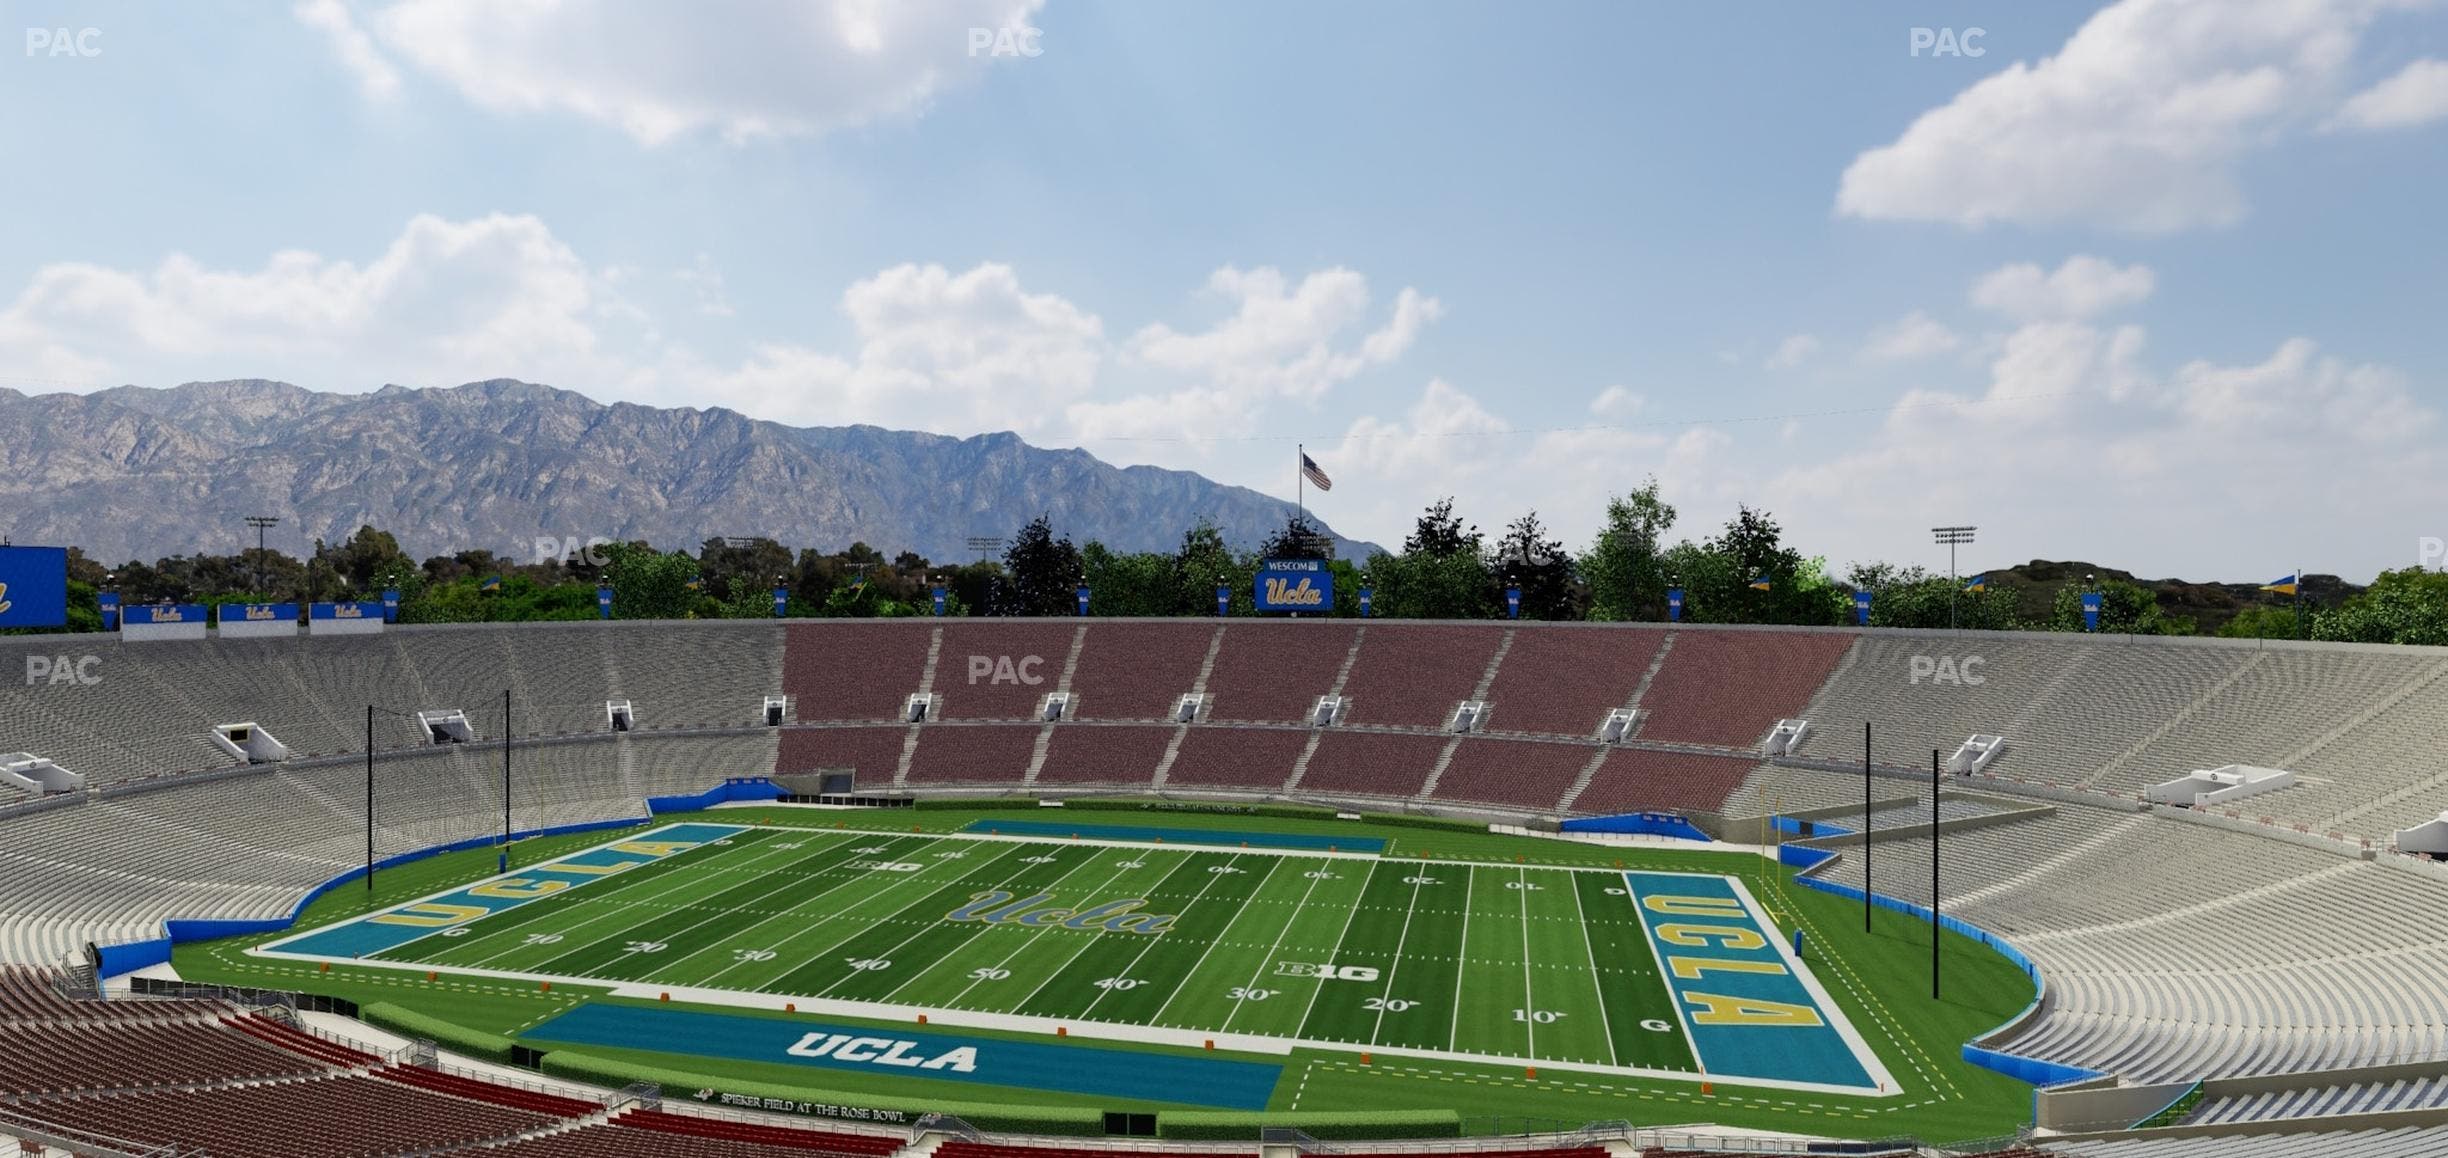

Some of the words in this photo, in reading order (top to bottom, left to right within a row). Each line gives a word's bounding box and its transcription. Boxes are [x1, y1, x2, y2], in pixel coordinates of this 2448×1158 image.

[1268, 561, 1307, 571] WESCOM
[1265, 577, 1322, 605] Ucla
[365, 841, 701, 928] UCLA
[943, 890, 1178, 934] Ucla
[1643, 894, 1825, 1027] UCLA
[967, 967, 1010, 980] 50
[1093, 977, 1136, 991] 40
[1226, 987, 1269, 1001] 30
[1362, 997, 1409, 1012] 20
[1512, 1009, 1556, 1023] 10
[1639, 1018, 1672, 1032] G
[786, 1031, 978, 1073] UCLA
[721, 1092, 761, 1107] SPIEKER
[764, 1098, 794, 1112] FIELD
[797, 1102, 812, 1113] AT
[815, 1104, 838, 1117] THE
[841, 1106, 870, 1120] ROSE
[873, 1109, 906, 1123] BOWL
